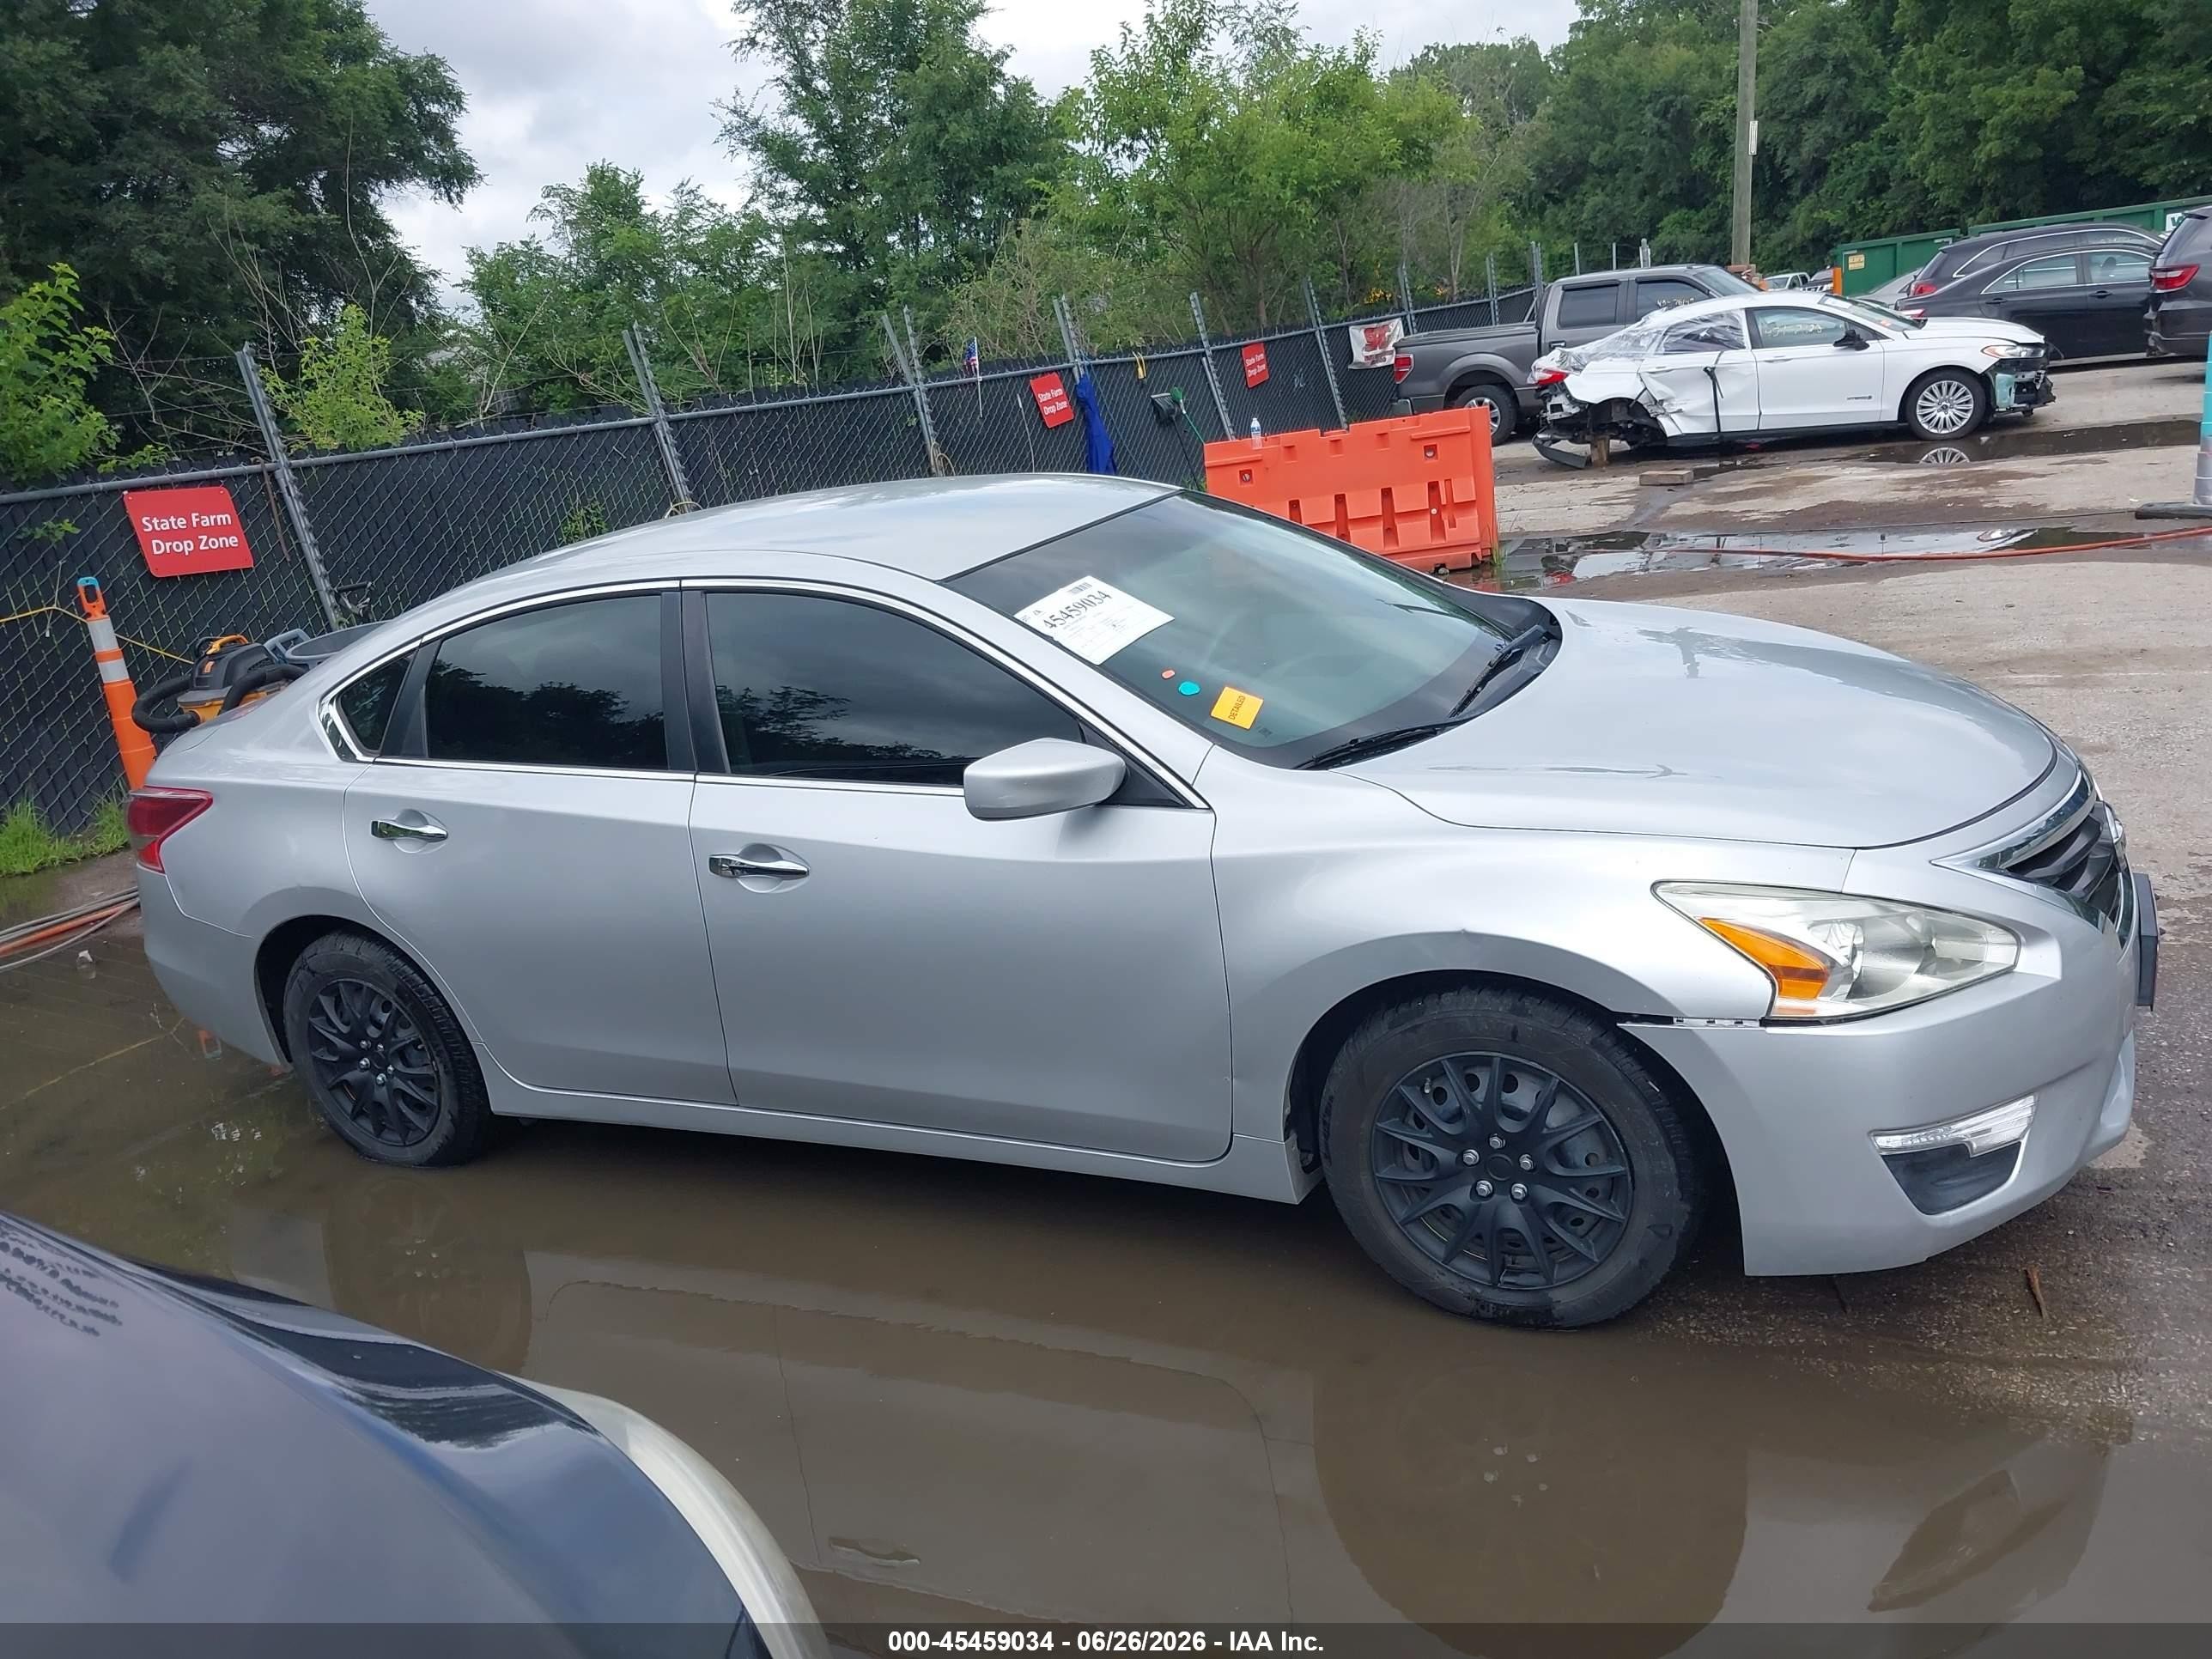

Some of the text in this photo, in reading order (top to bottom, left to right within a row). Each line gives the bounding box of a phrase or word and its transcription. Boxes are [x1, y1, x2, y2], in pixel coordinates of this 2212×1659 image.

[1037, 392, 1052, 403] State
[1042, 400, 1068, 416] Drop Zone
[142, 513, 232, 532] State Farm
[151, 534, 239, 556] Drop Zone
[1043, 590, 1113, 629] 45459034
[1228, 695, 1247, 720] DETAILED
